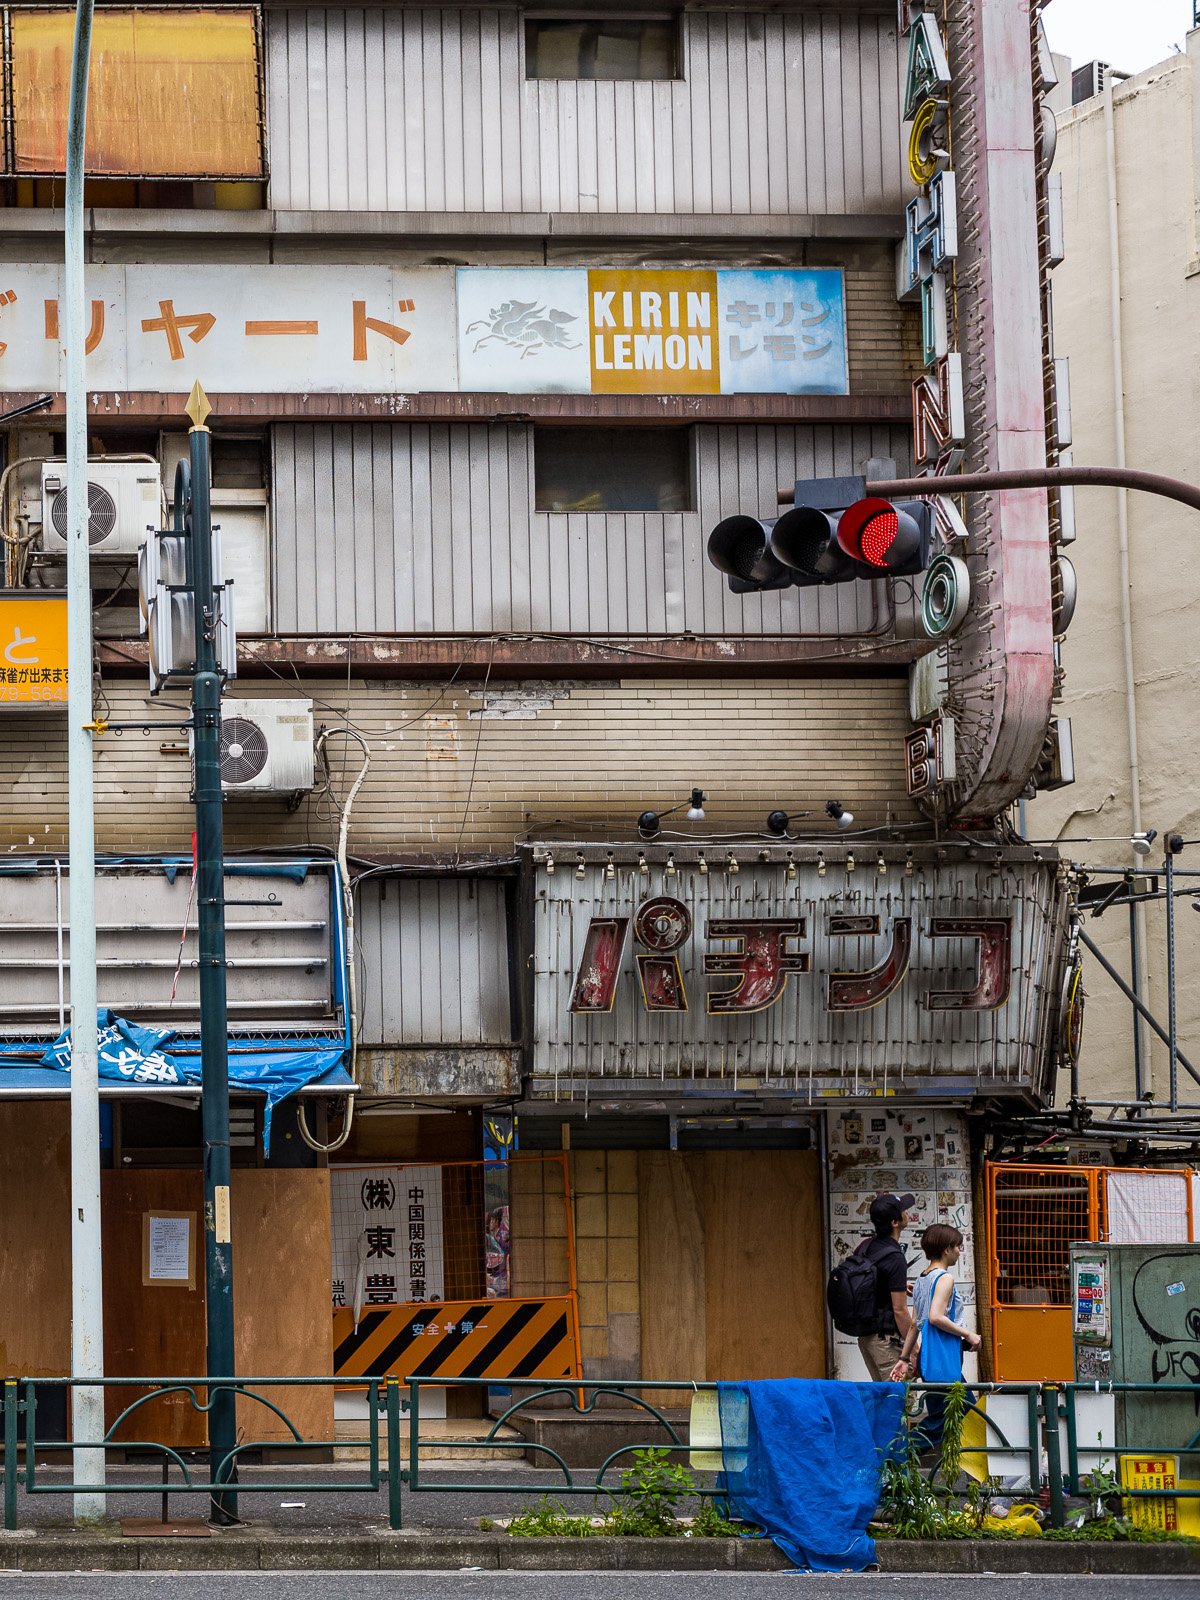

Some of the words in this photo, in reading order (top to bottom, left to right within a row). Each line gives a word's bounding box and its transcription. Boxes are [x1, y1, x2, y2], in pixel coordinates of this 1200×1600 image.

[594, 290, 711, 329] KIRIN
[726, 300, 831, 328] キリン
[595, 334, 711, 371] LEMON
[730, 333, 832, 361] レモン
[568, 896, 1012, 1014] パチンコ
[408, 1185, 427, 1303] 中国関係図書
[412, 1323, 440, 1337] 安全
[461, 1320, 489, 1334] 第一
[1138, 1462, 1163, 1473] 警告
